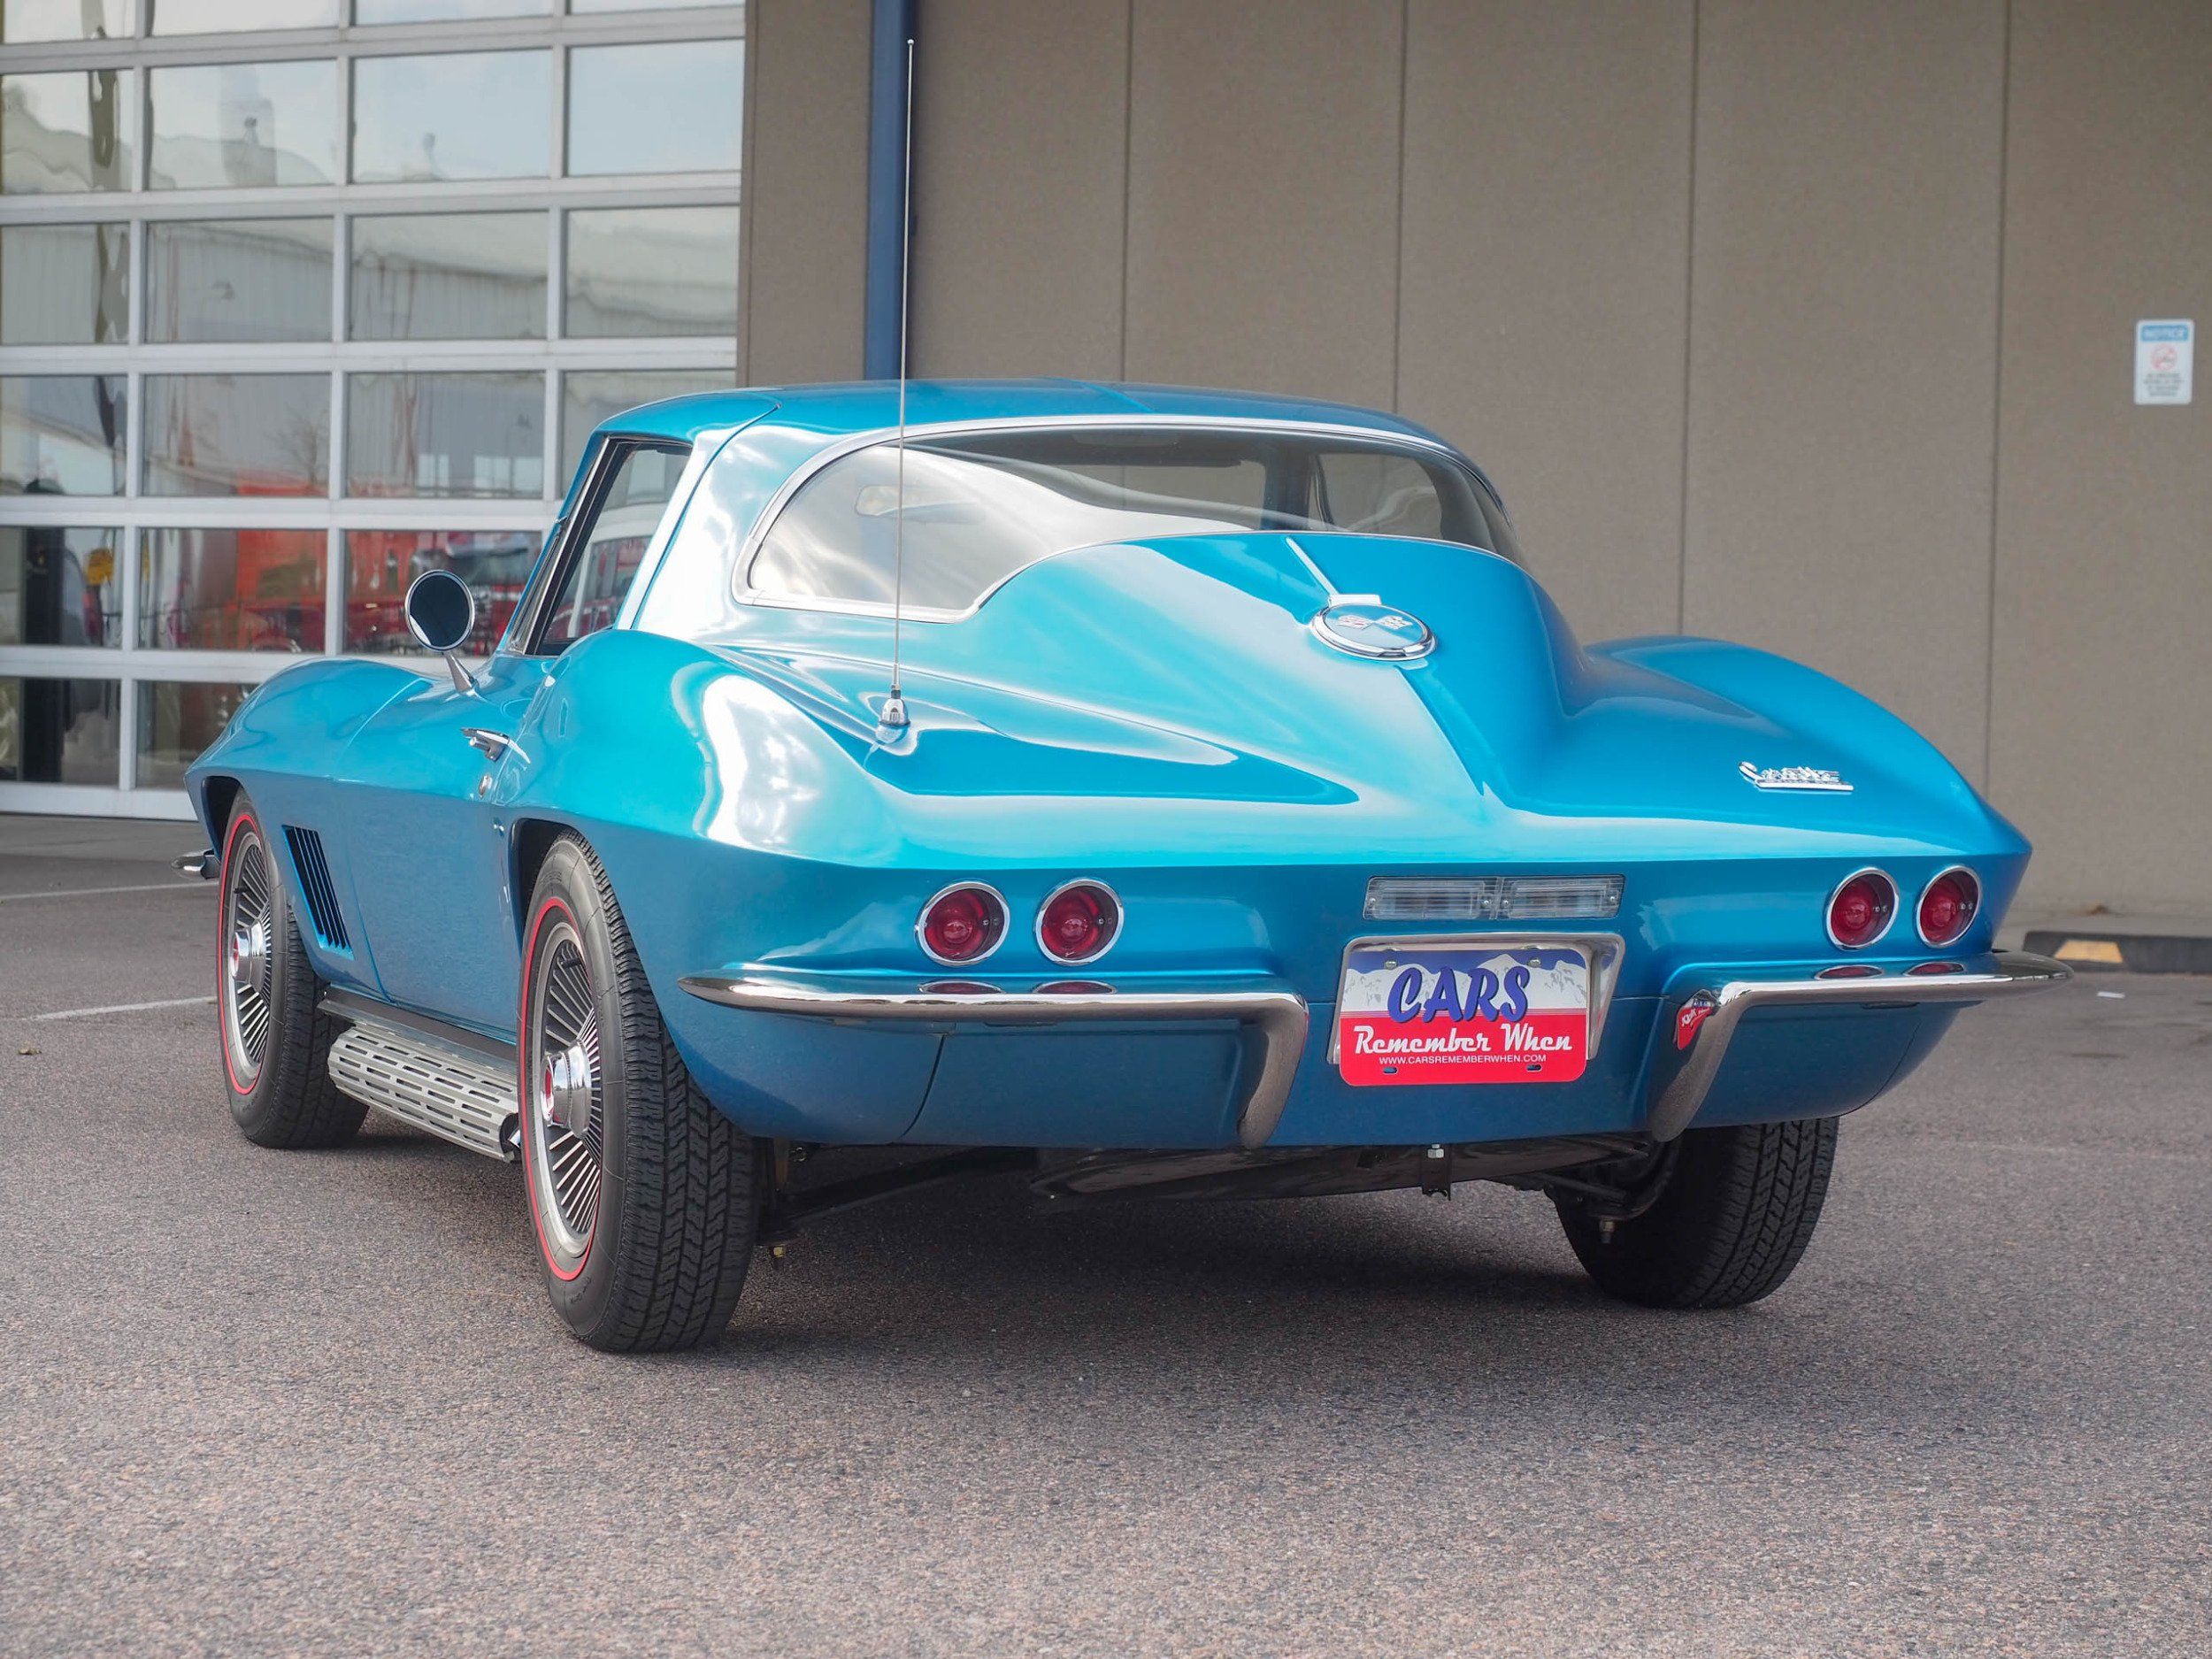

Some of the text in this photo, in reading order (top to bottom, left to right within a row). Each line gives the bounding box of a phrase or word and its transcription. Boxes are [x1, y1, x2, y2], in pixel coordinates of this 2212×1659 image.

[1387, 965, 1531, 1023] CARS
[1354, 1023, 1573, 1055] Remember When
[1379, 1054, 1547, 1065] WWW.CARSREMEMBERWHEN.COM
